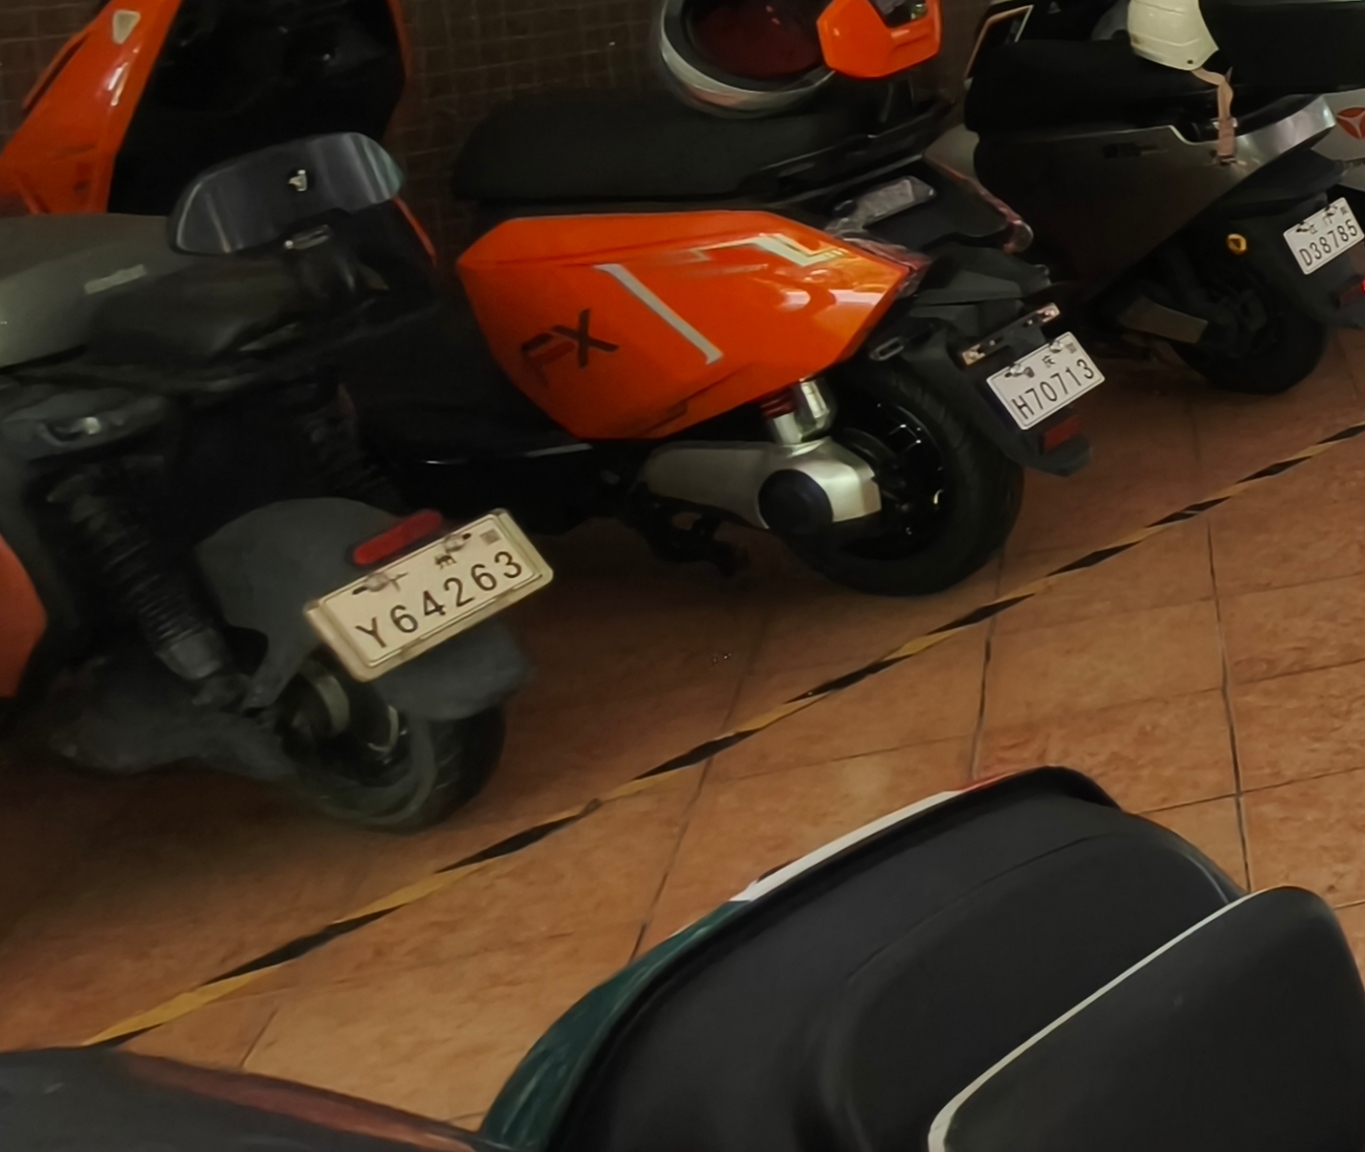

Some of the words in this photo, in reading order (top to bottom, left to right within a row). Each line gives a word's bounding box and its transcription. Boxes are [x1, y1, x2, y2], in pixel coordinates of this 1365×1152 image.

[1299, 218, 1358, 266] D38785
[1011, 358, 1095, 420] H70713
[355, 551, 523, 649] Y64263
